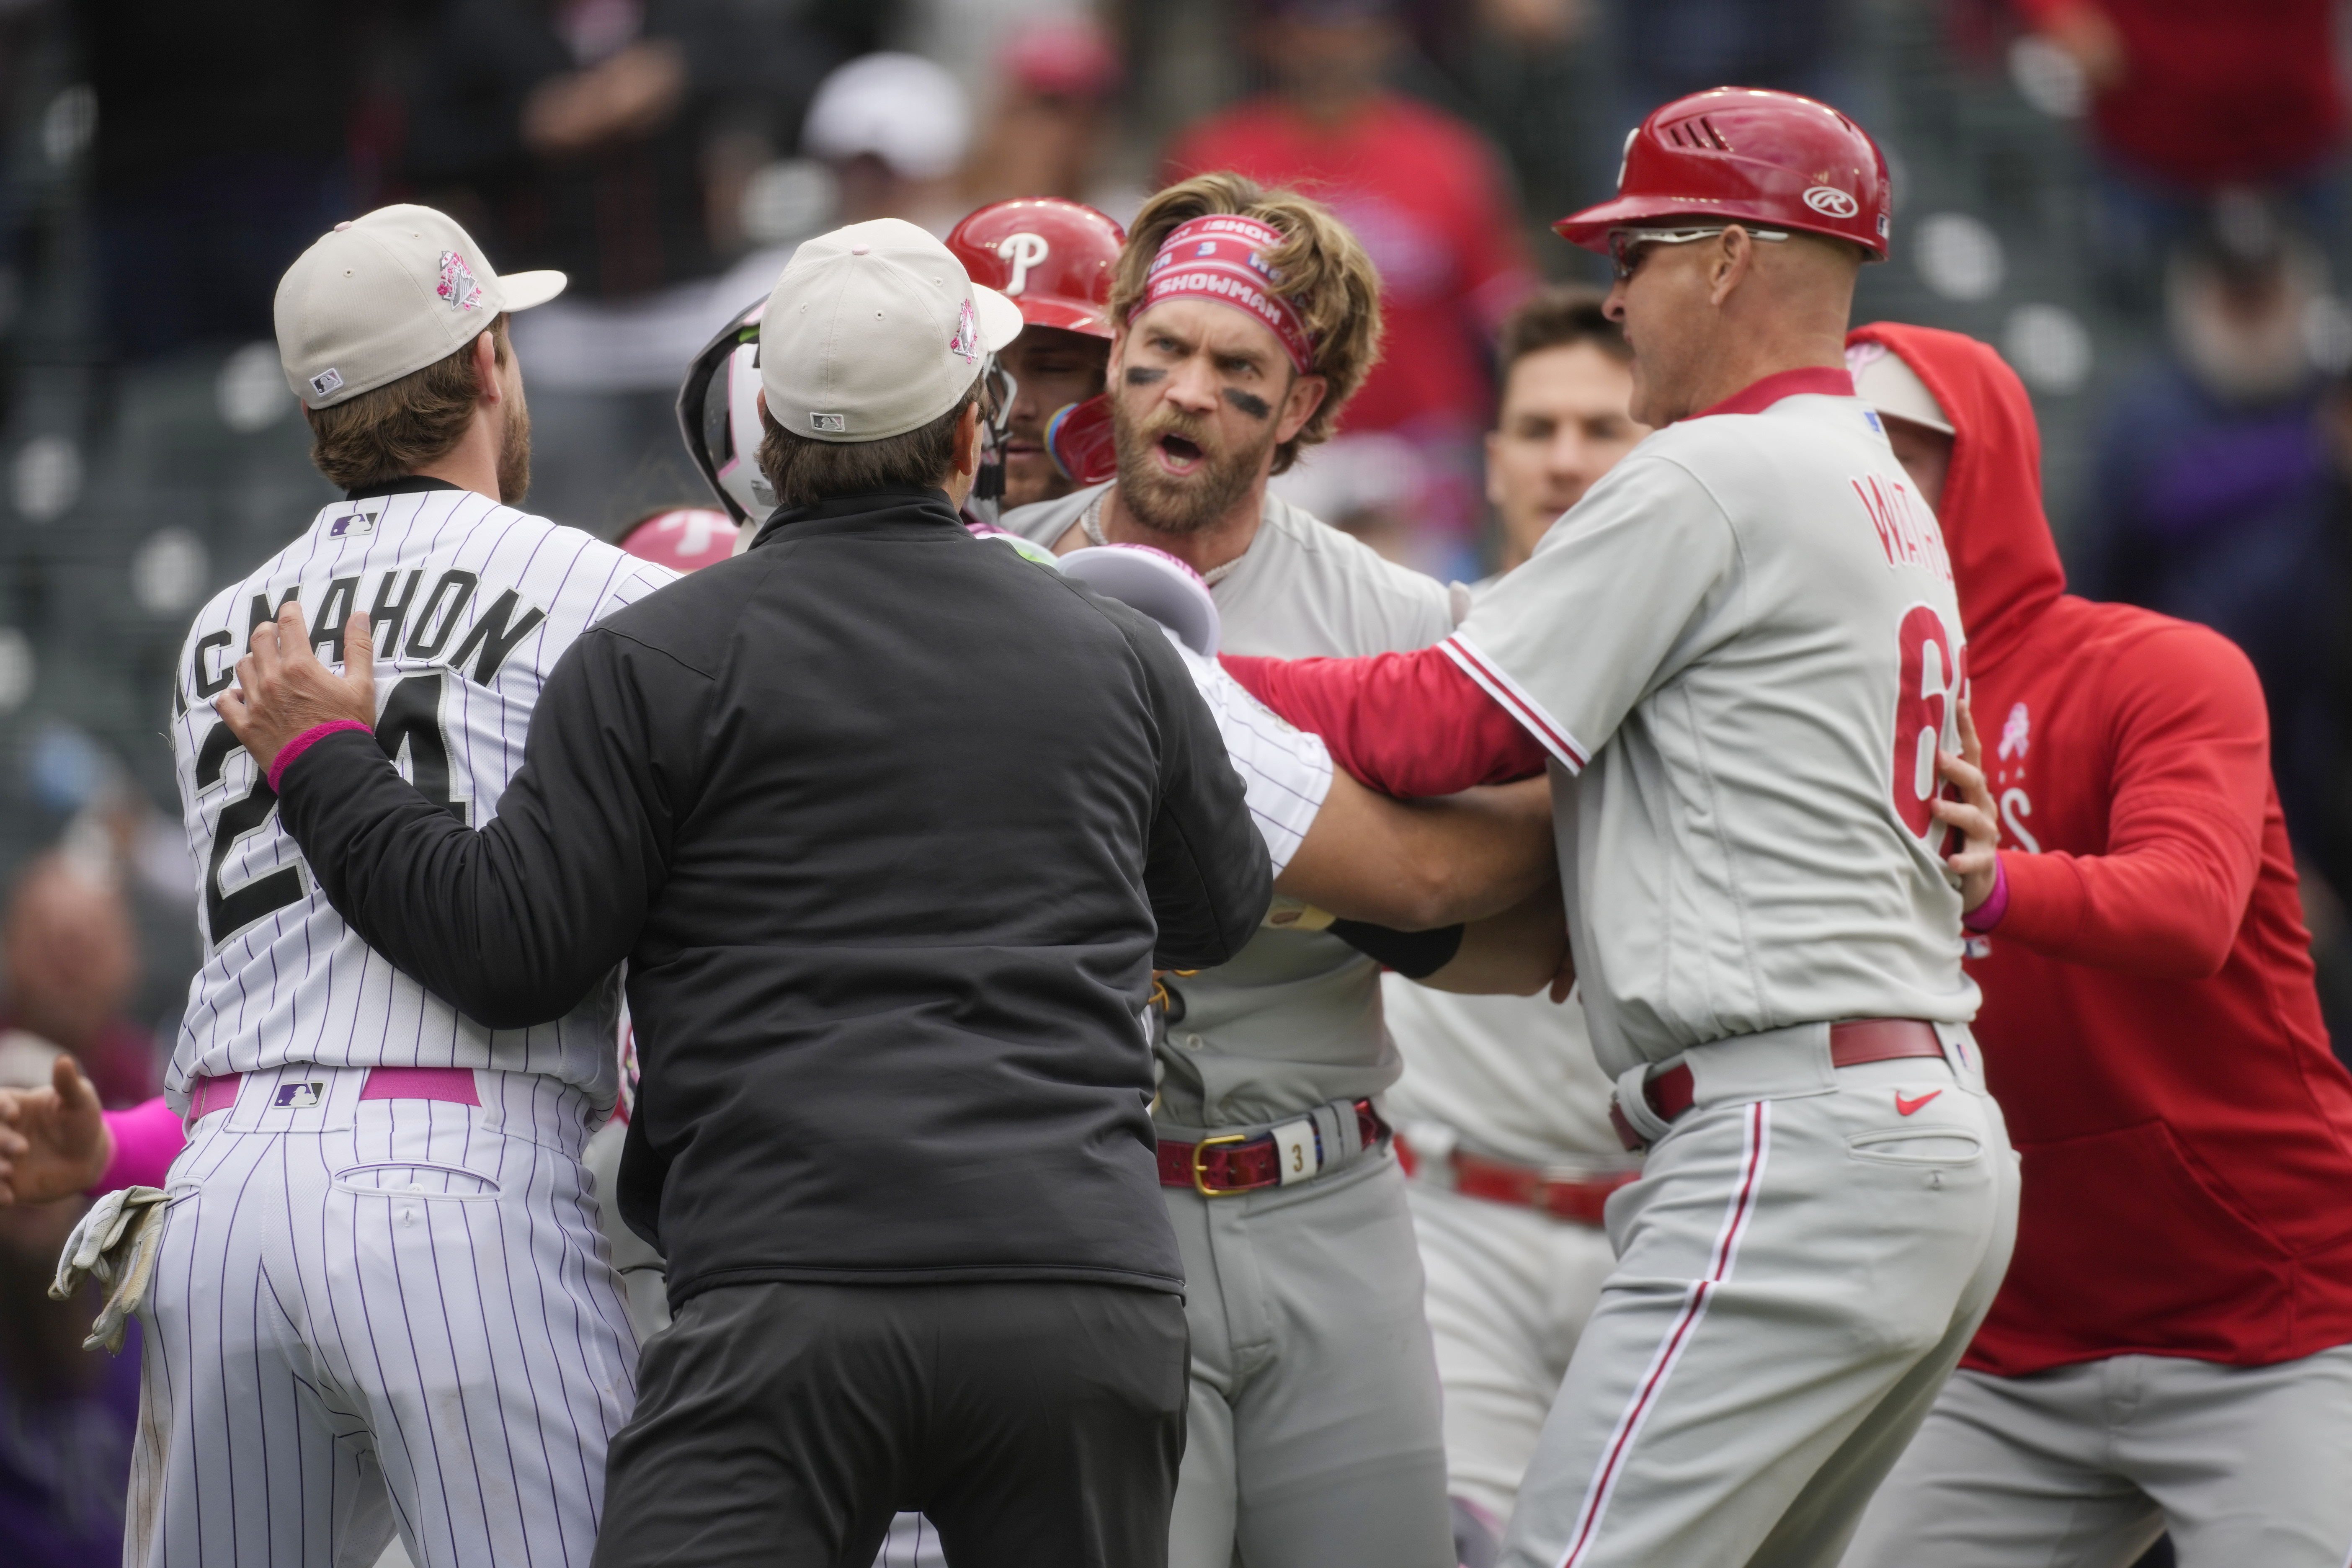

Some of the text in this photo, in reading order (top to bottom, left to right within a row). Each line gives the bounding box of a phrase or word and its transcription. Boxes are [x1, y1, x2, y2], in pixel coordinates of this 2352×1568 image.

[998, 232, 1049, 297] P
[1195, 241, 1216, 257] 3
[1892, 603, 1970, 842] 6
[1291, 1144, 1304, 1172] 3
